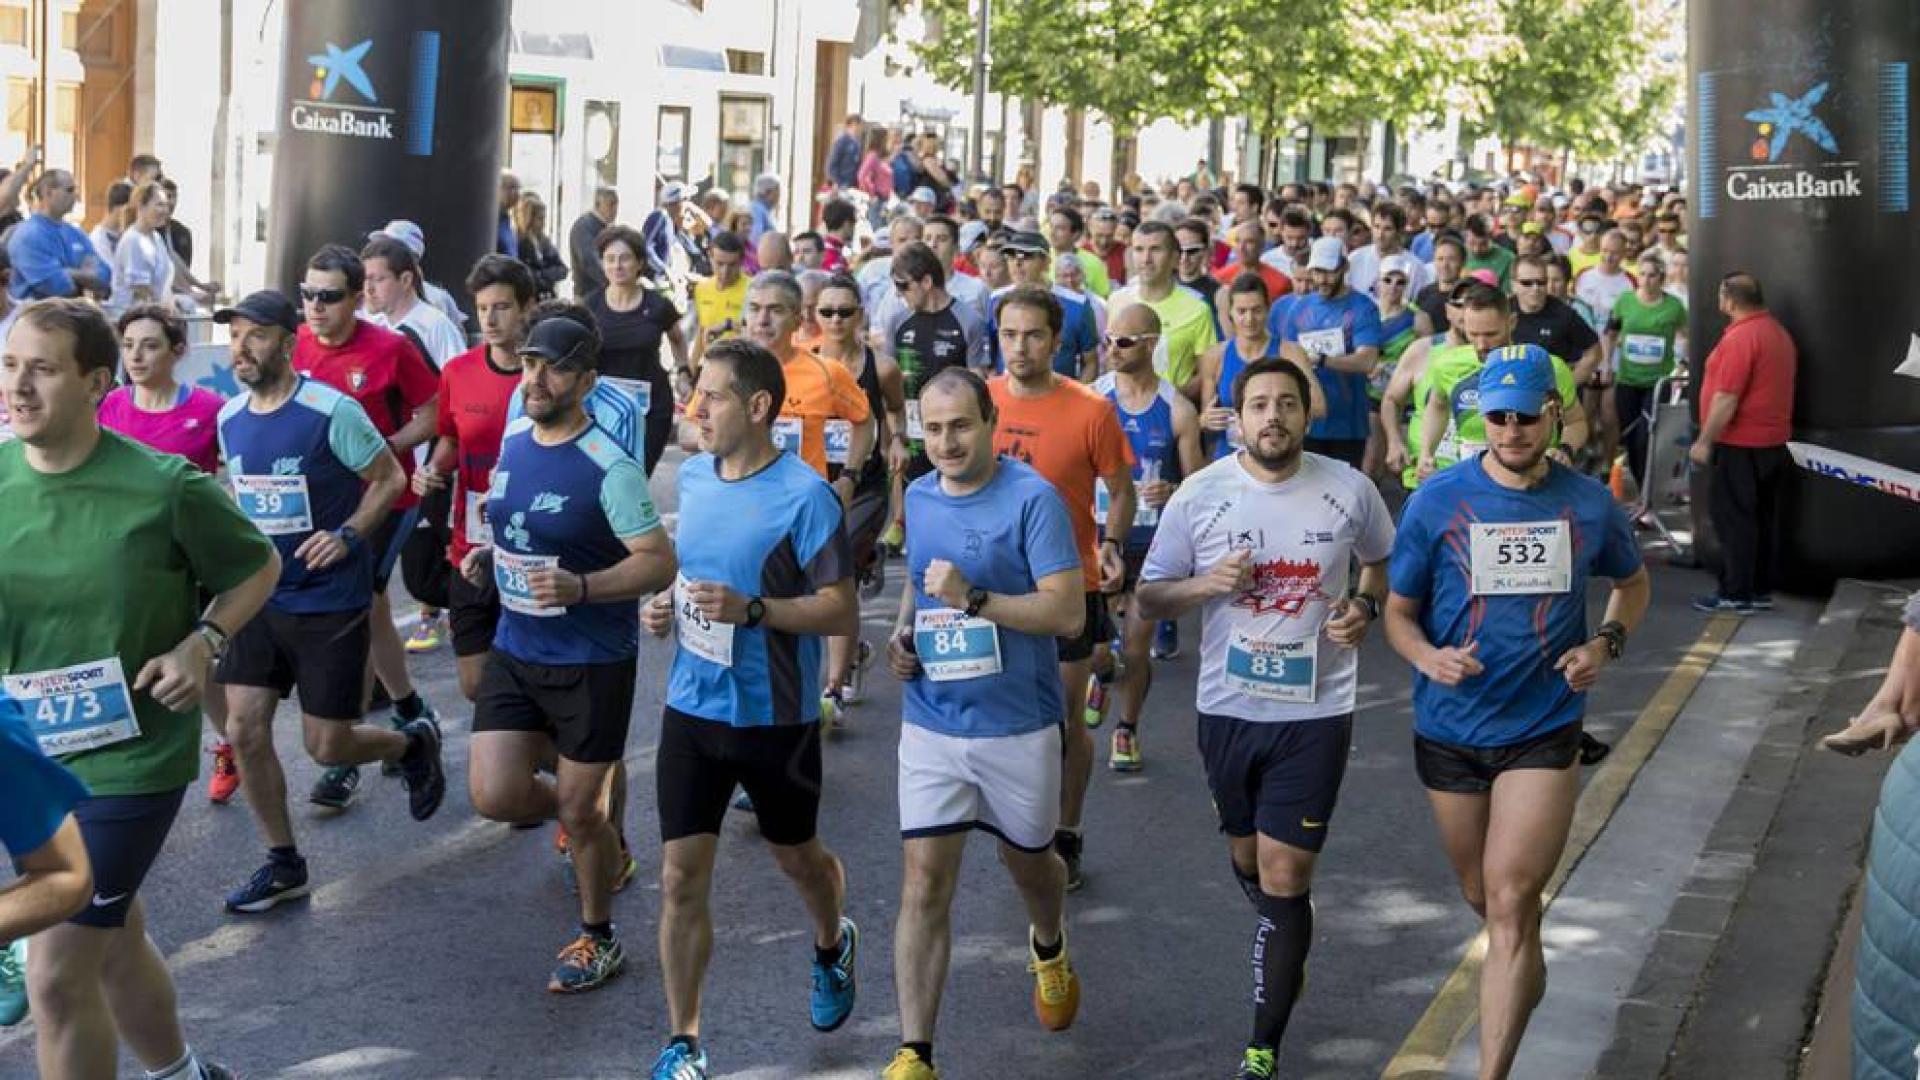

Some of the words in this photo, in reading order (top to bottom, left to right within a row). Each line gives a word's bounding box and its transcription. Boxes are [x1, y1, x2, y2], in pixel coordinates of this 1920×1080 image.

[291, 106, 393, 139] CaixaBank
[1727, 171, 1862, 200] CaixaBank
[255, 493, 281, 512] 39
[1497, 543, 1546, 564] 532
[935, 631, 967, 654] 84
[1251, 656, 1285, 677] 83
[36, 691, 101, 725] 473
